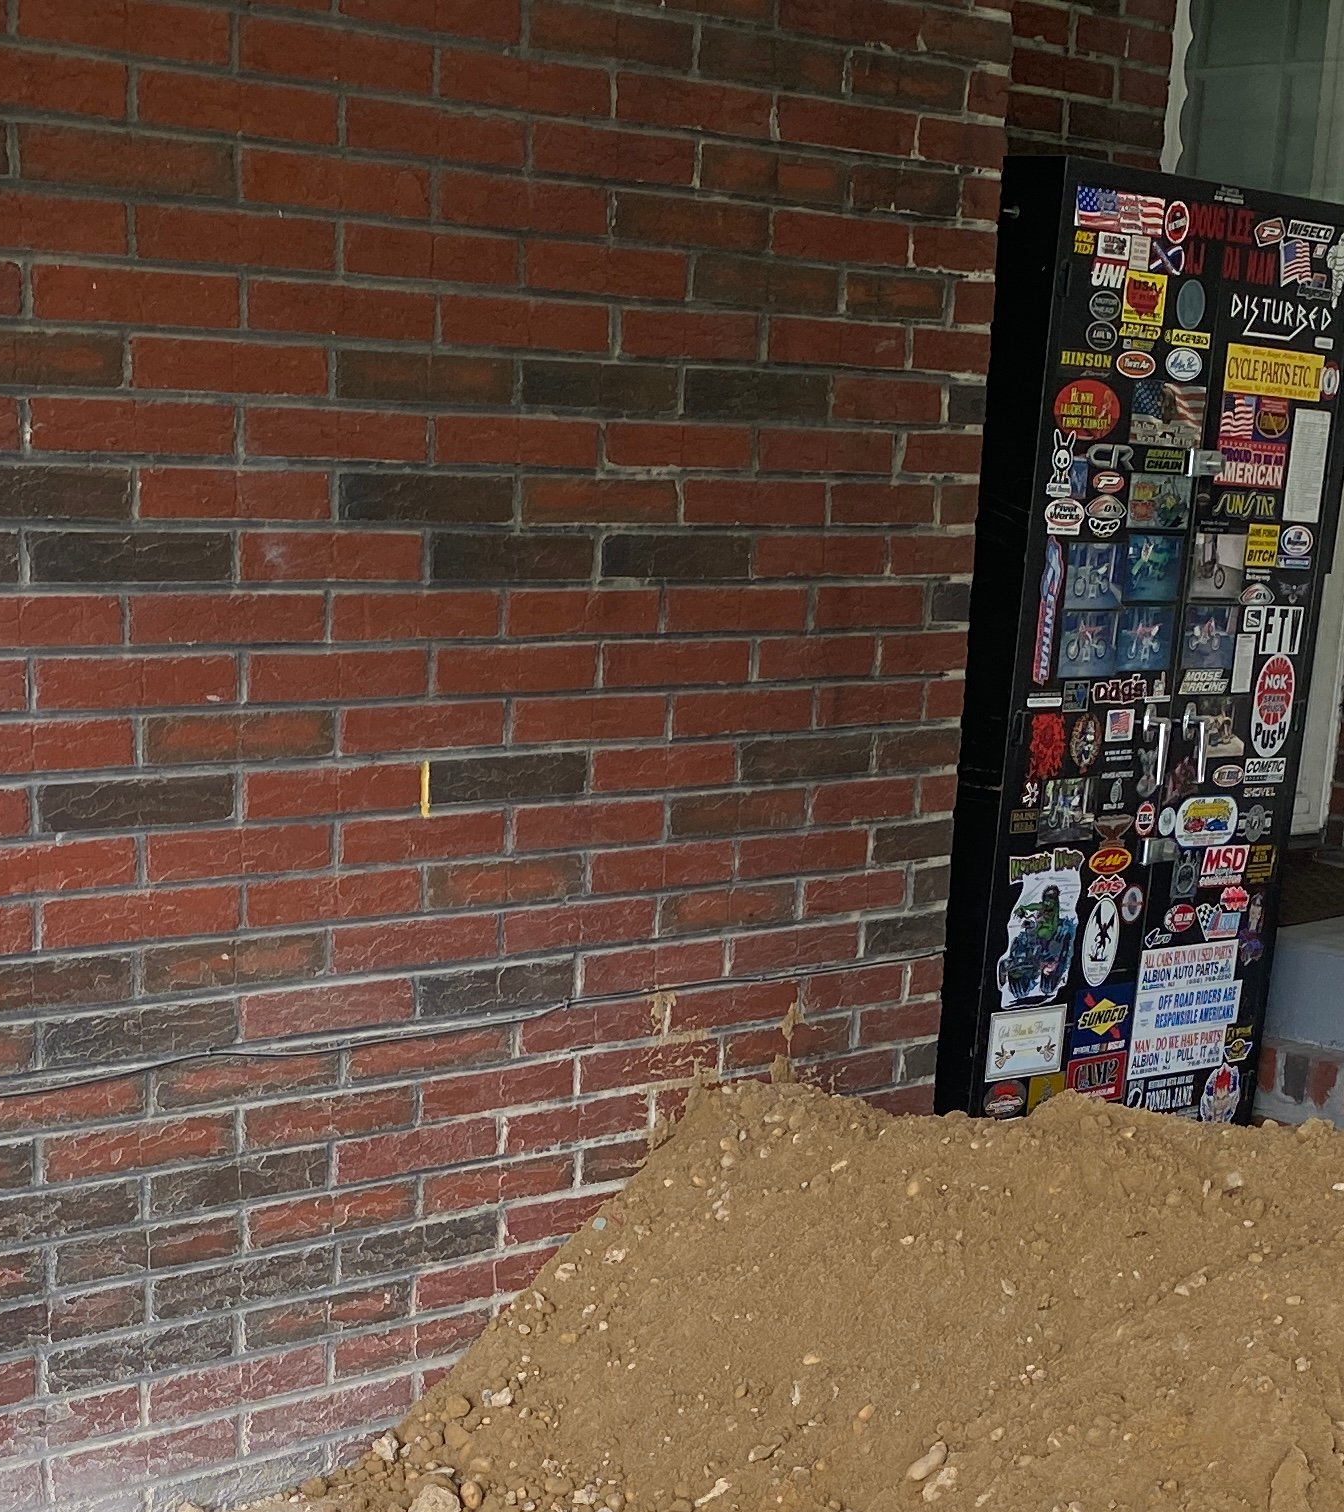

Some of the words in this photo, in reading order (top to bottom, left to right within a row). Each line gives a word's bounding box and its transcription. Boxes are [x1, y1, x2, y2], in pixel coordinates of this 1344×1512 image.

[1227, 207, 1255, 245] LEE
[1289, 221, 1332, 240] WISECO
[1222, 246, 1240, 281] DA
[1231, 293, 1332, 341] DISTURBED
[1119, 323, 1162, 340] APPLIED
[1060, 350, 1112, 369] HINSON
[1227, 357, 1259, 381] CYCLE
[1261, 361, 1291, 386] PARTS
[1292, 365, 1312, 388] ETC.
[1088, 444, 1134, 471] CR
[1146, 459, 1183, 471] CHAIN
[1049, 511, 1080, 520] Works
[1054, 503, 1078, 512] Pivot
[1090, 519, 1120, 531] UFO
[1247, 550, 1275, 562] BITCH
[1186, 671, 1222, 681] MOOSE
[1264, 674, 1288, 690] NGK
[1188, 681, 1227, 692] RACING
[1253, 722, 1287, 749] PUSH
[1246, 760, 1285, 774] COMETIC
[1138, 813, 1152, 823] EBC
[1094, 855, 1127, 867] FMF
[1203, 847, 1246, 872] MSD
[1091, 881, 1123, 893] IMS
[1144, 952, 1155, 969] ALL
[1156, 950, 1173, 967] CARS
[1197, 946, 1213, 963] USED
[1142, 967, 1172, 984] ALBION
[1173, 965, 1194, 980] AUTO
[1195, 961, 1220, 977] PARTS
[1158, 994, 1174, 1011] OFF
[1175, 992, 1195, 1009] ROAD
[1196, 988, 1222, 1006] RIDERS
[1223, 986, 1238, 1002] ARE
[1079, 1006, 1126, 1028] SUNOCO
[1154, 1008, 1198, 1029] RESPONSIBLE
[1199, 1003, 1235, 1023] AMERICANS
[1134, 1040, 1151, 1054] MAN
[1156, 1037, 1168, 1051] DO
[1169, 1035, 1180, 1049] WE
[1181, 1033, 1199, 1048] HAVE
[1131, 1053, 1159, 1069] ALBION
[1165, 1051, 1172, 1064] U
[1176, 1048, 1194, 1063] PULL
[1199, 1045, 1207, 1060] IT
